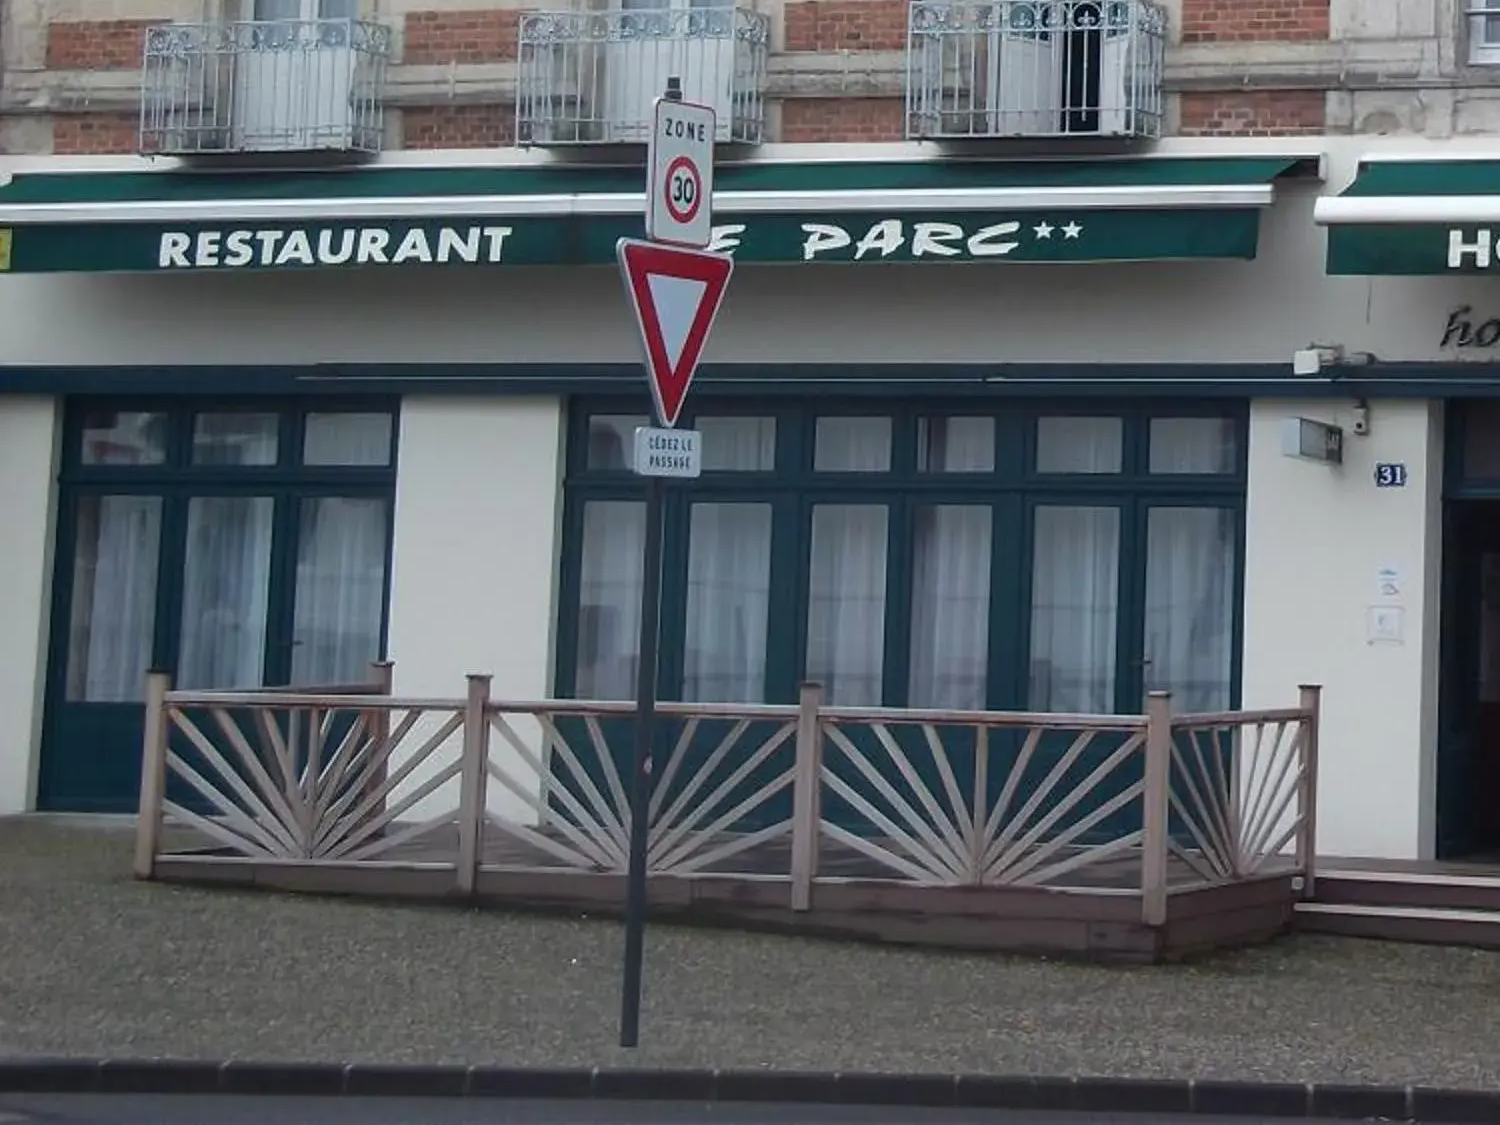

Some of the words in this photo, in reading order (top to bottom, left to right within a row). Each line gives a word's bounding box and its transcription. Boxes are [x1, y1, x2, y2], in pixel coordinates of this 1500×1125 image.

[665, 117, 706, 144] ZONE
[672, 175, 695, 205] 30
[158, 225, 513, 268] RESTAURANT
[801, 219, 1020, 261] PARC
[649, 455, 690, 470] PASSAGE
[1379, 466, 1402, 484] 31
